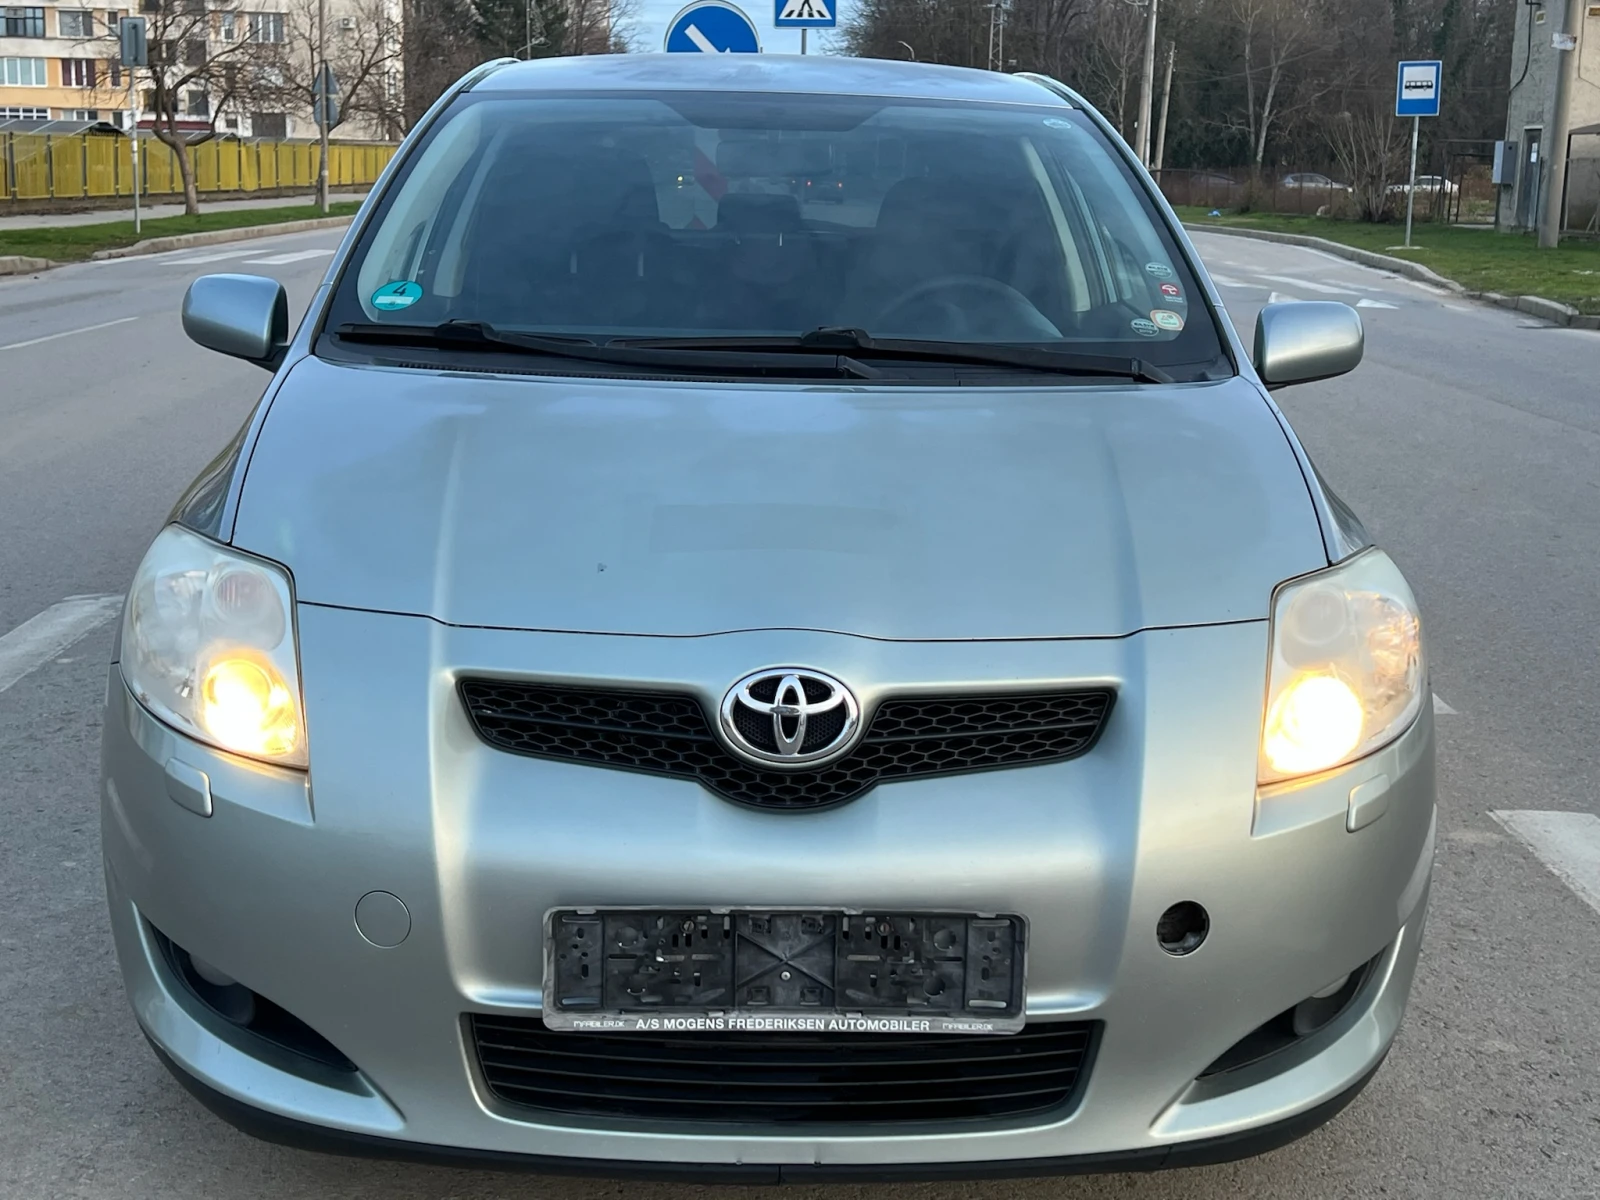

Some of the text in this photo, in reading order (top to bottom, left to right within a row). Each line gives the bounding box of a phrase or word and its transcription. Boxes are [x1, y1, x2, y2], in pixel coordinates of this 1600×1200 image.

[392, 281, 408, 296] 4
[636, 1018, 930, 1031] A/S MOGENS FREDERIKSEN AUTOMOBILER
